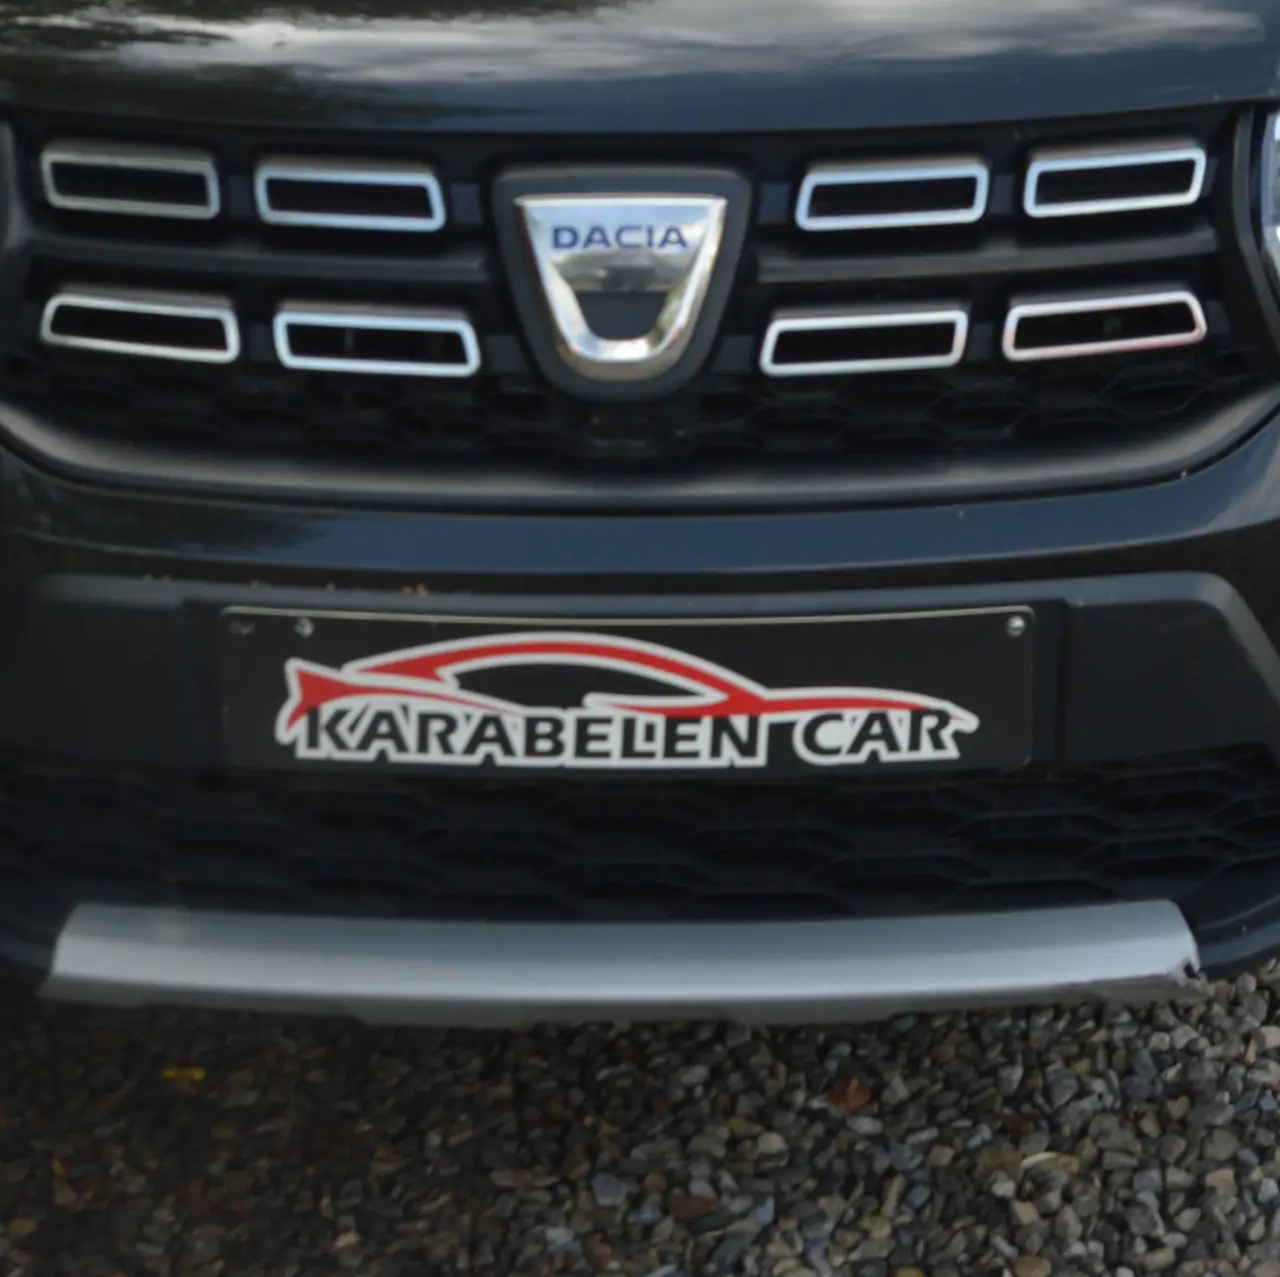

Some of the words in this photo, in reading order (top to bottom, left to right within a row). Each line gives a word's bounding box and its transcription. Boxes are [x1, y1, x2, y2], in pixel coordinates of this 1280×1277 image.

[551, 226, 689, 249] DACIA
[306, 707, 760, 760] KARABELEN
[802, 708, 952, 757] CAR
